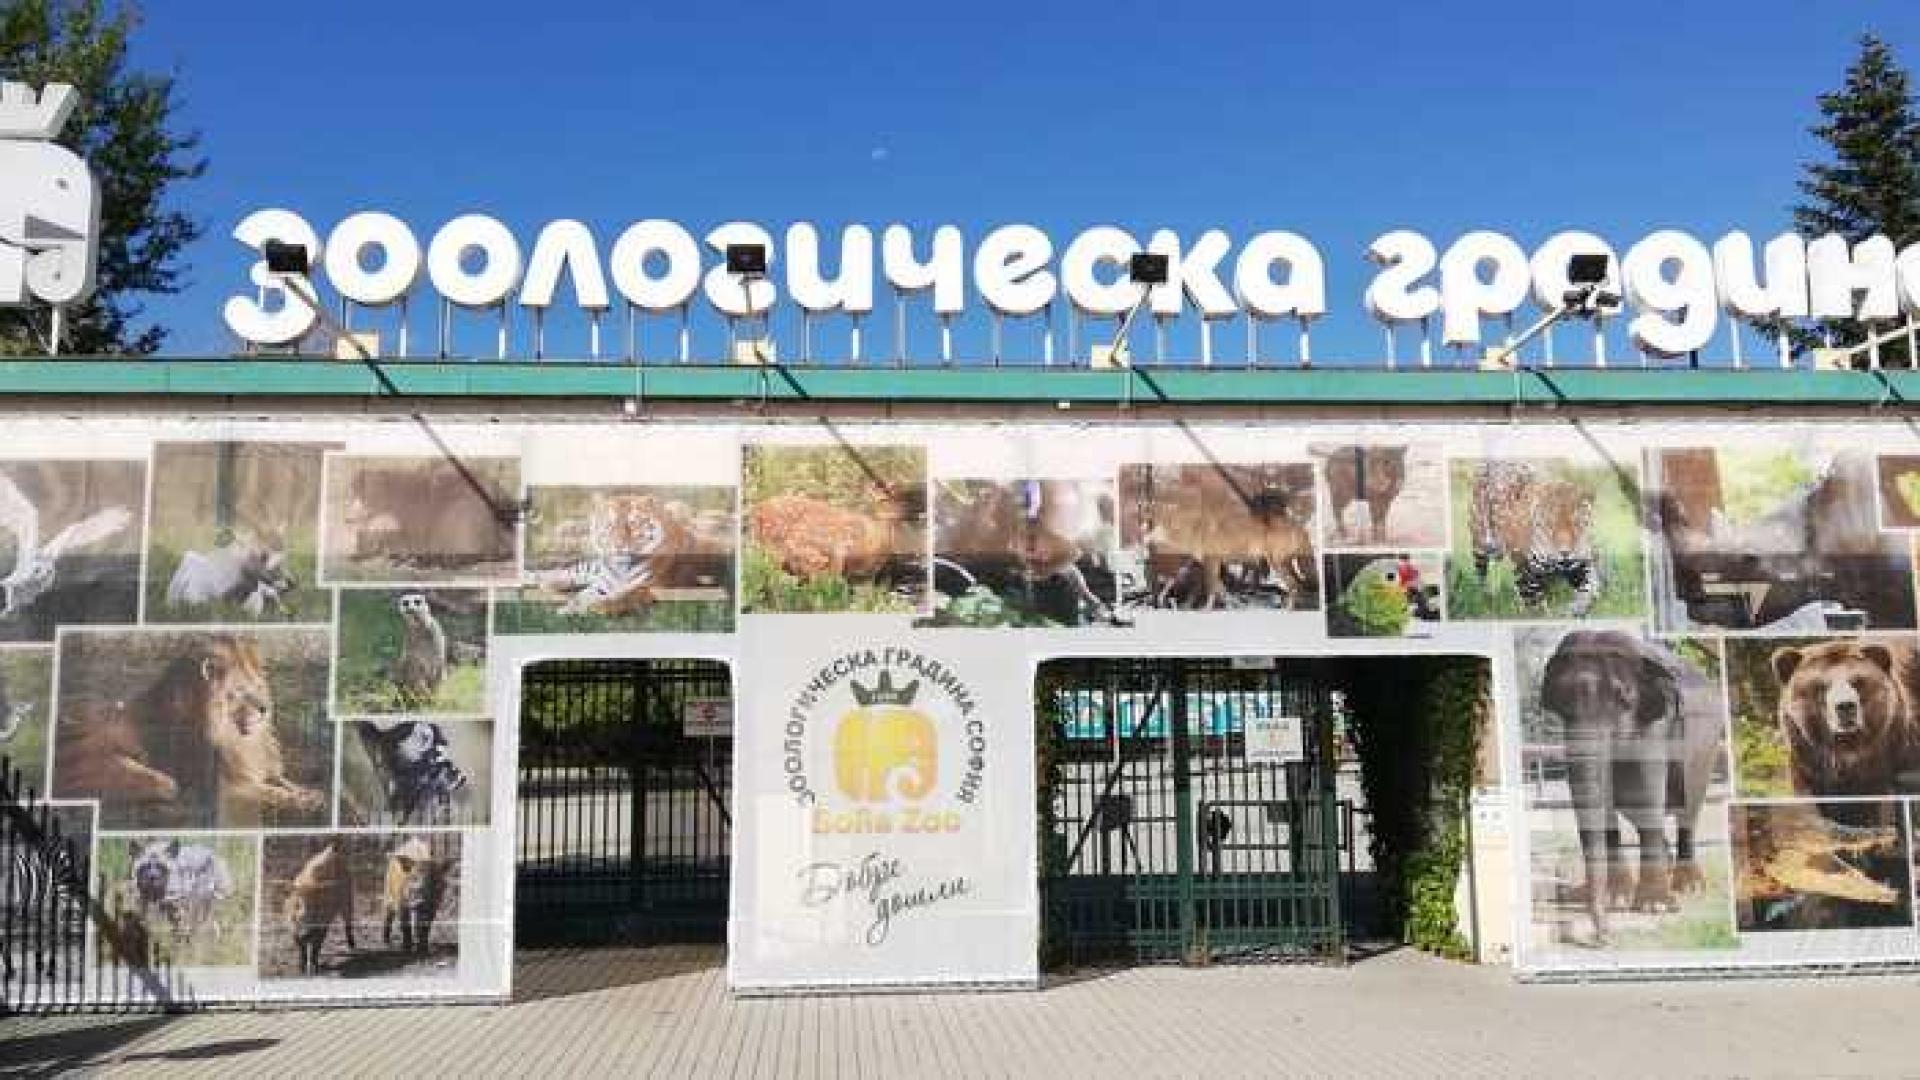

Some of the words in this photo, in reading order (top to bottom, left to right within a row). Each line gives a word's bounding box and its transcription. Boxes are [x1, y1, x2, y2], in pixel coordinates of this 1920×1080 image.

[1363, 229, 1920, 356] градин
[885, 646, 974, 716] ГРАДИНА
[957, 720, 985, 804] СОФИЯ
